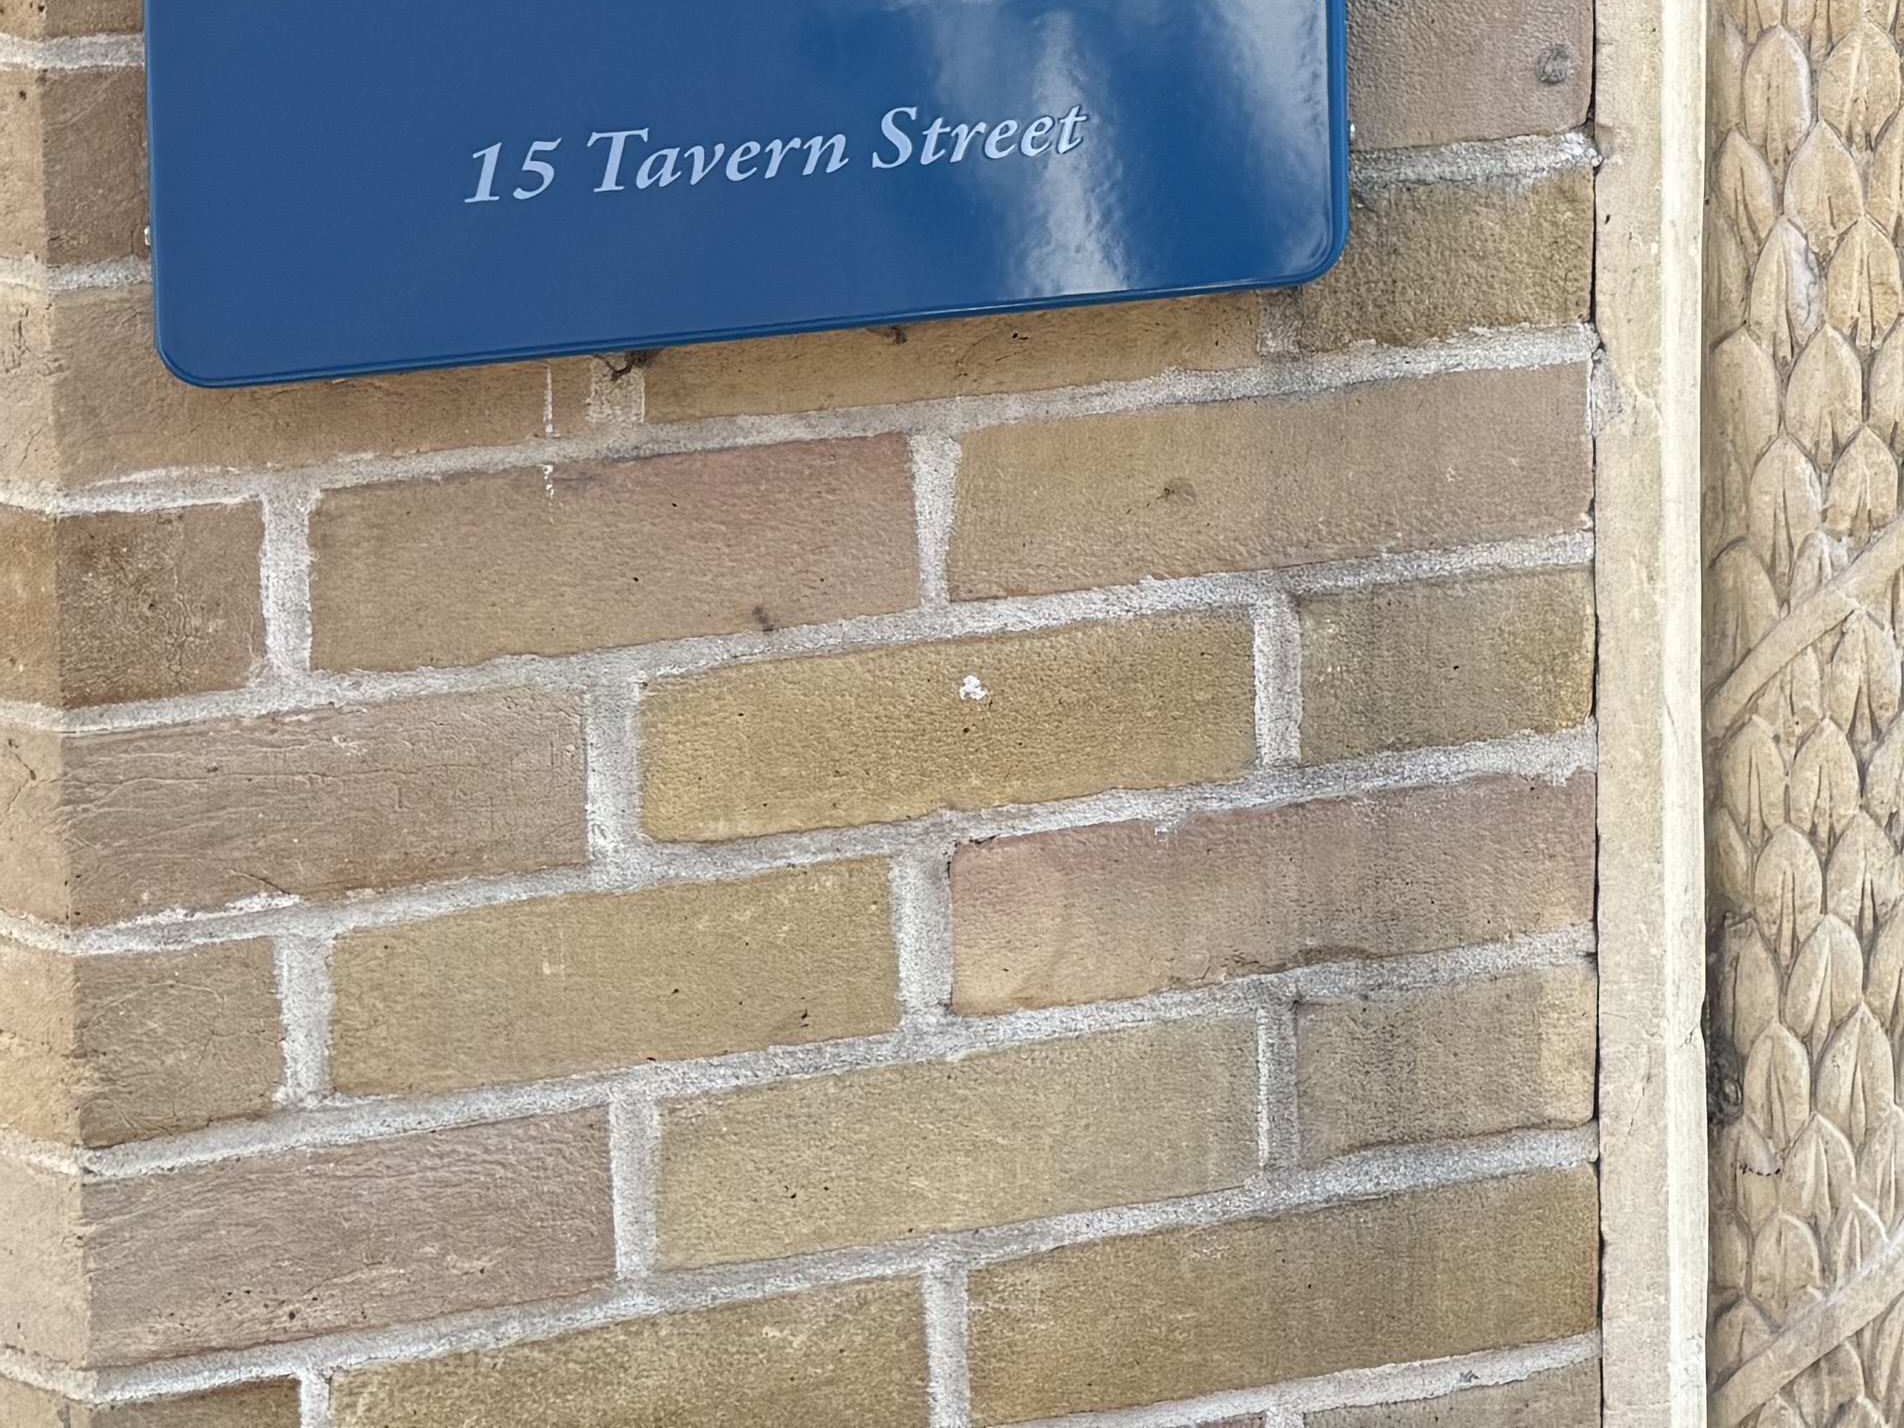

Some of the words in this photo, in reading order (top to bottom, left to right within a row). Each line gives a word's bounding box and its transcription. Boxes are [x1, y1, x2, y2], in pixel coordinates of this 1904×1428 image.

[463, 137, 563, 204] 15
[587, 127, 850, 193] Tavern
[872, 103, 1090, 170] Street
